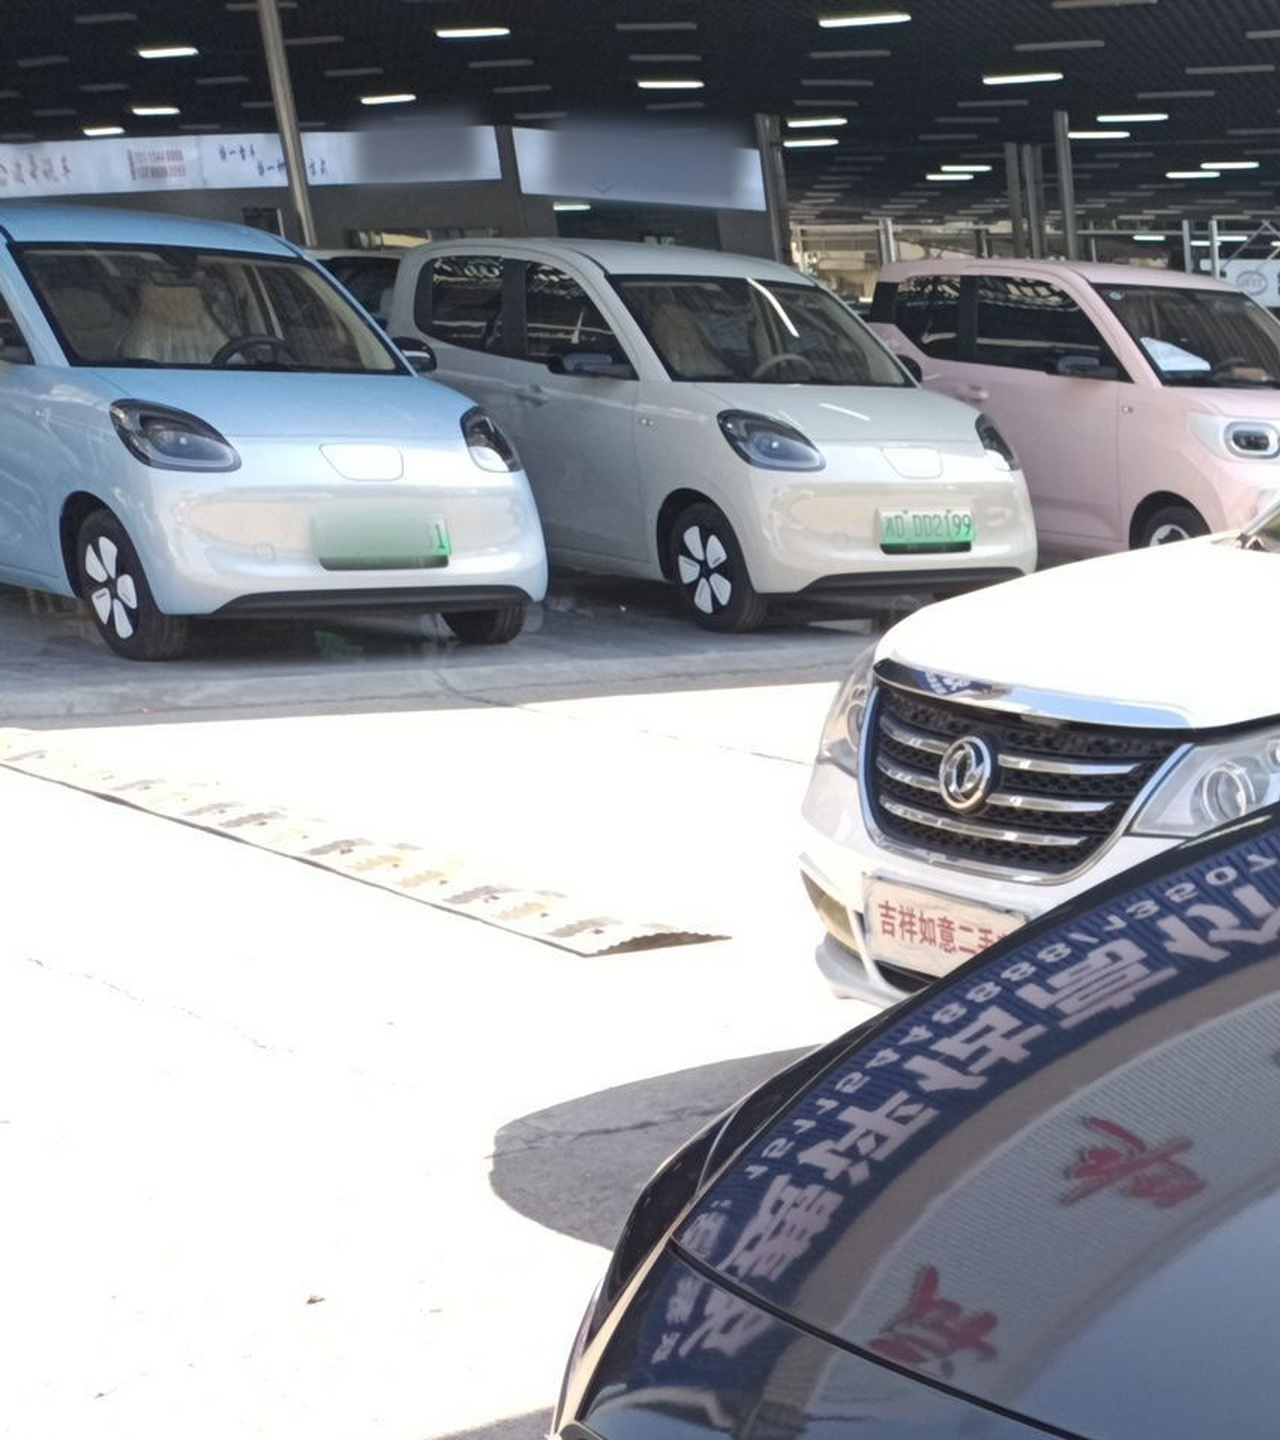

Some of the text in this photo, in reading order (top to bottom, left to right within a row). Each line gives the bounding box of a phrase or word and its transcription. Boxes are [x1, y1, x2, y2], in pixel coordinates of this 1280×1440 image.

[878, 900, 1008, 955] 吉祥如意二手
